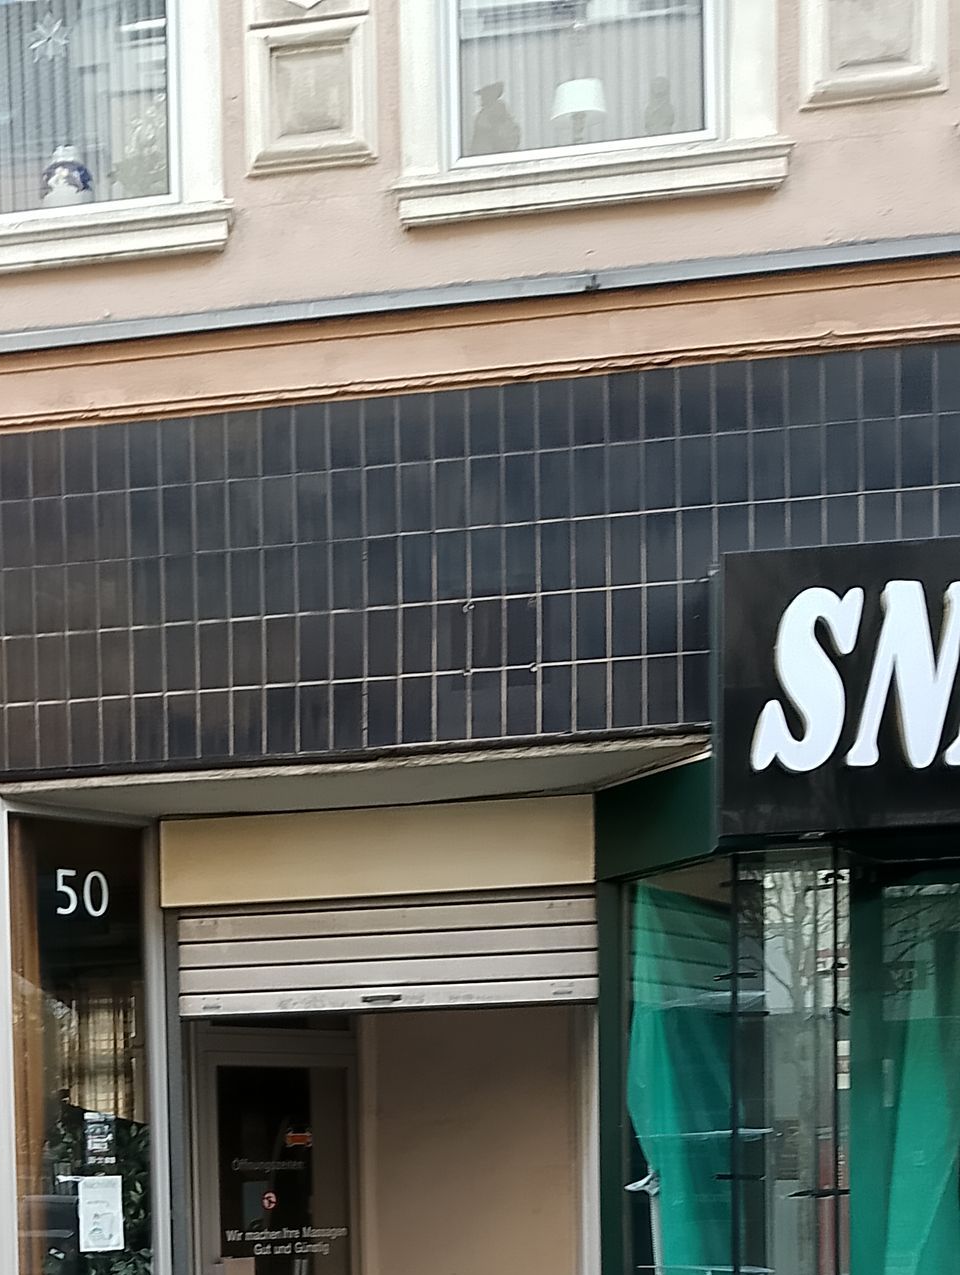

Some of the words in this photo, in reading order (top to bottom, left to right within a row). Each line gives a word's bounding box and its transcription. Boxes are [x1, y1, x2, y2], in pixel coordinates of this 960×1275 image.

[751, 579, 960, 772] SN
[55, 869, 109, 917] 50
[225, 1229, 243, 1241] Wir
[254, 1243, 272, 1255] Gut
[273, 1242, 292, 1254] und
